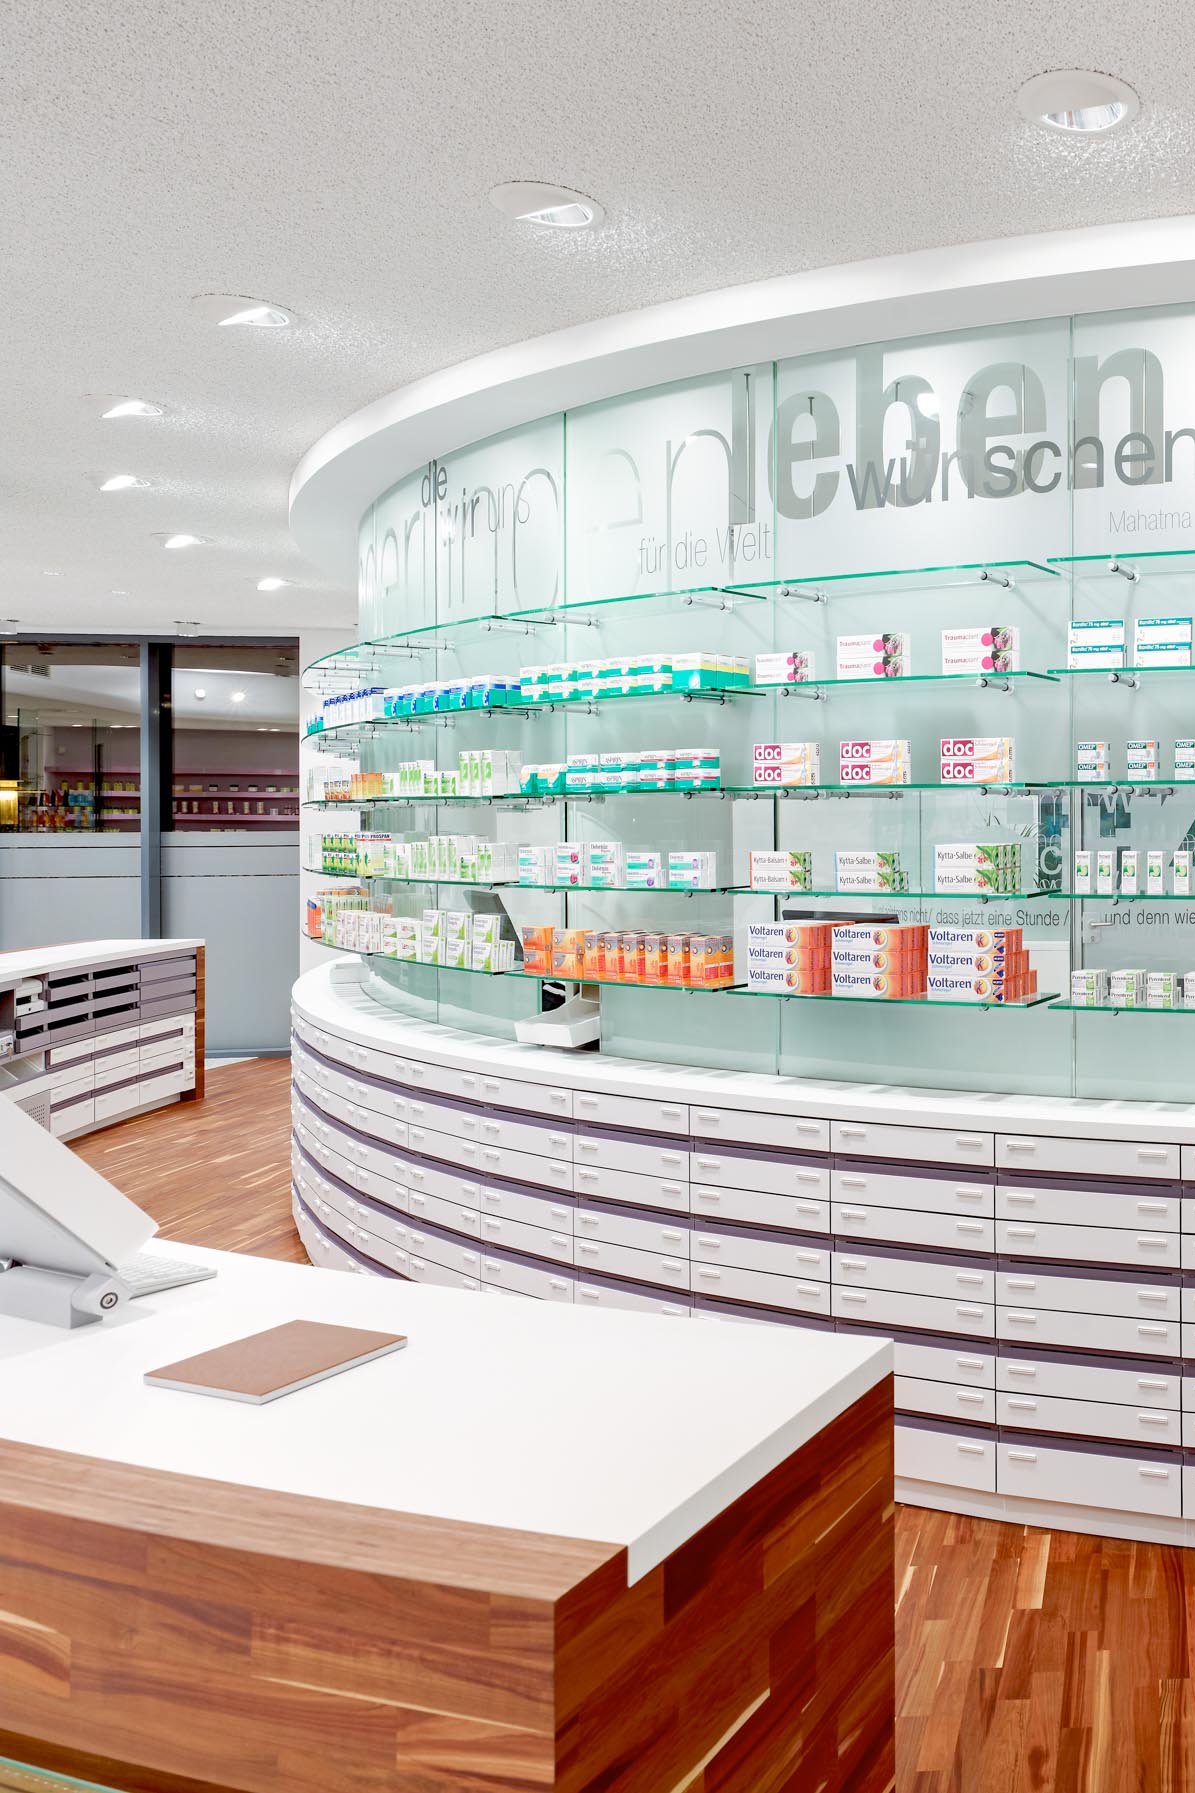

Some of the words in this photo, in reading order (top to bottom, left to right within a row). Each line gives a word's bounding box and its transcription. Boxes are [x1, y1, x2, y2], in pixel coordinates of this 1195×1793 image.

[729, 347, 1163, 524] leben
[421, 459, 447, 508] die
[1109, 507, 1192, 533] Mahatma
[639, 537, 666, 575] für
[674, 532, 708, 570] die
[716, 522, 773, 564] Welt
[755, 745, 781, 760] doc
[841, 742, 871, 758] doc
[942, 740, 974, 756] doc
[755, 766, 781, 781] doc
[841, 764, 871, 780] doc
[942, 762, 974, 779] doc
[937, 910, 959, 925] dass
[961, 909, 984, 928] jetzt
[988, 909, 1012, 926] eine
[1016, 909, 1059, 926] Stunde
[1104, 908, 1131, 924] und
[1136, 908, 1170, 924] denn
[749, 925, 784, 936] Voltaren
[833, 928, 871, 939] Voltaren
[929, 930, 973, 942] Voltaren
[749, 947, 784, 958] Voltaren
[833, 951, 871, 962] Voltaren
[929, 953, 973, 965] Voltaren
[749, 969, 784, 981] Voltaren
[833, 973, 871, 985] Voltaren
[928, 976, 972, 989] Voltaren
